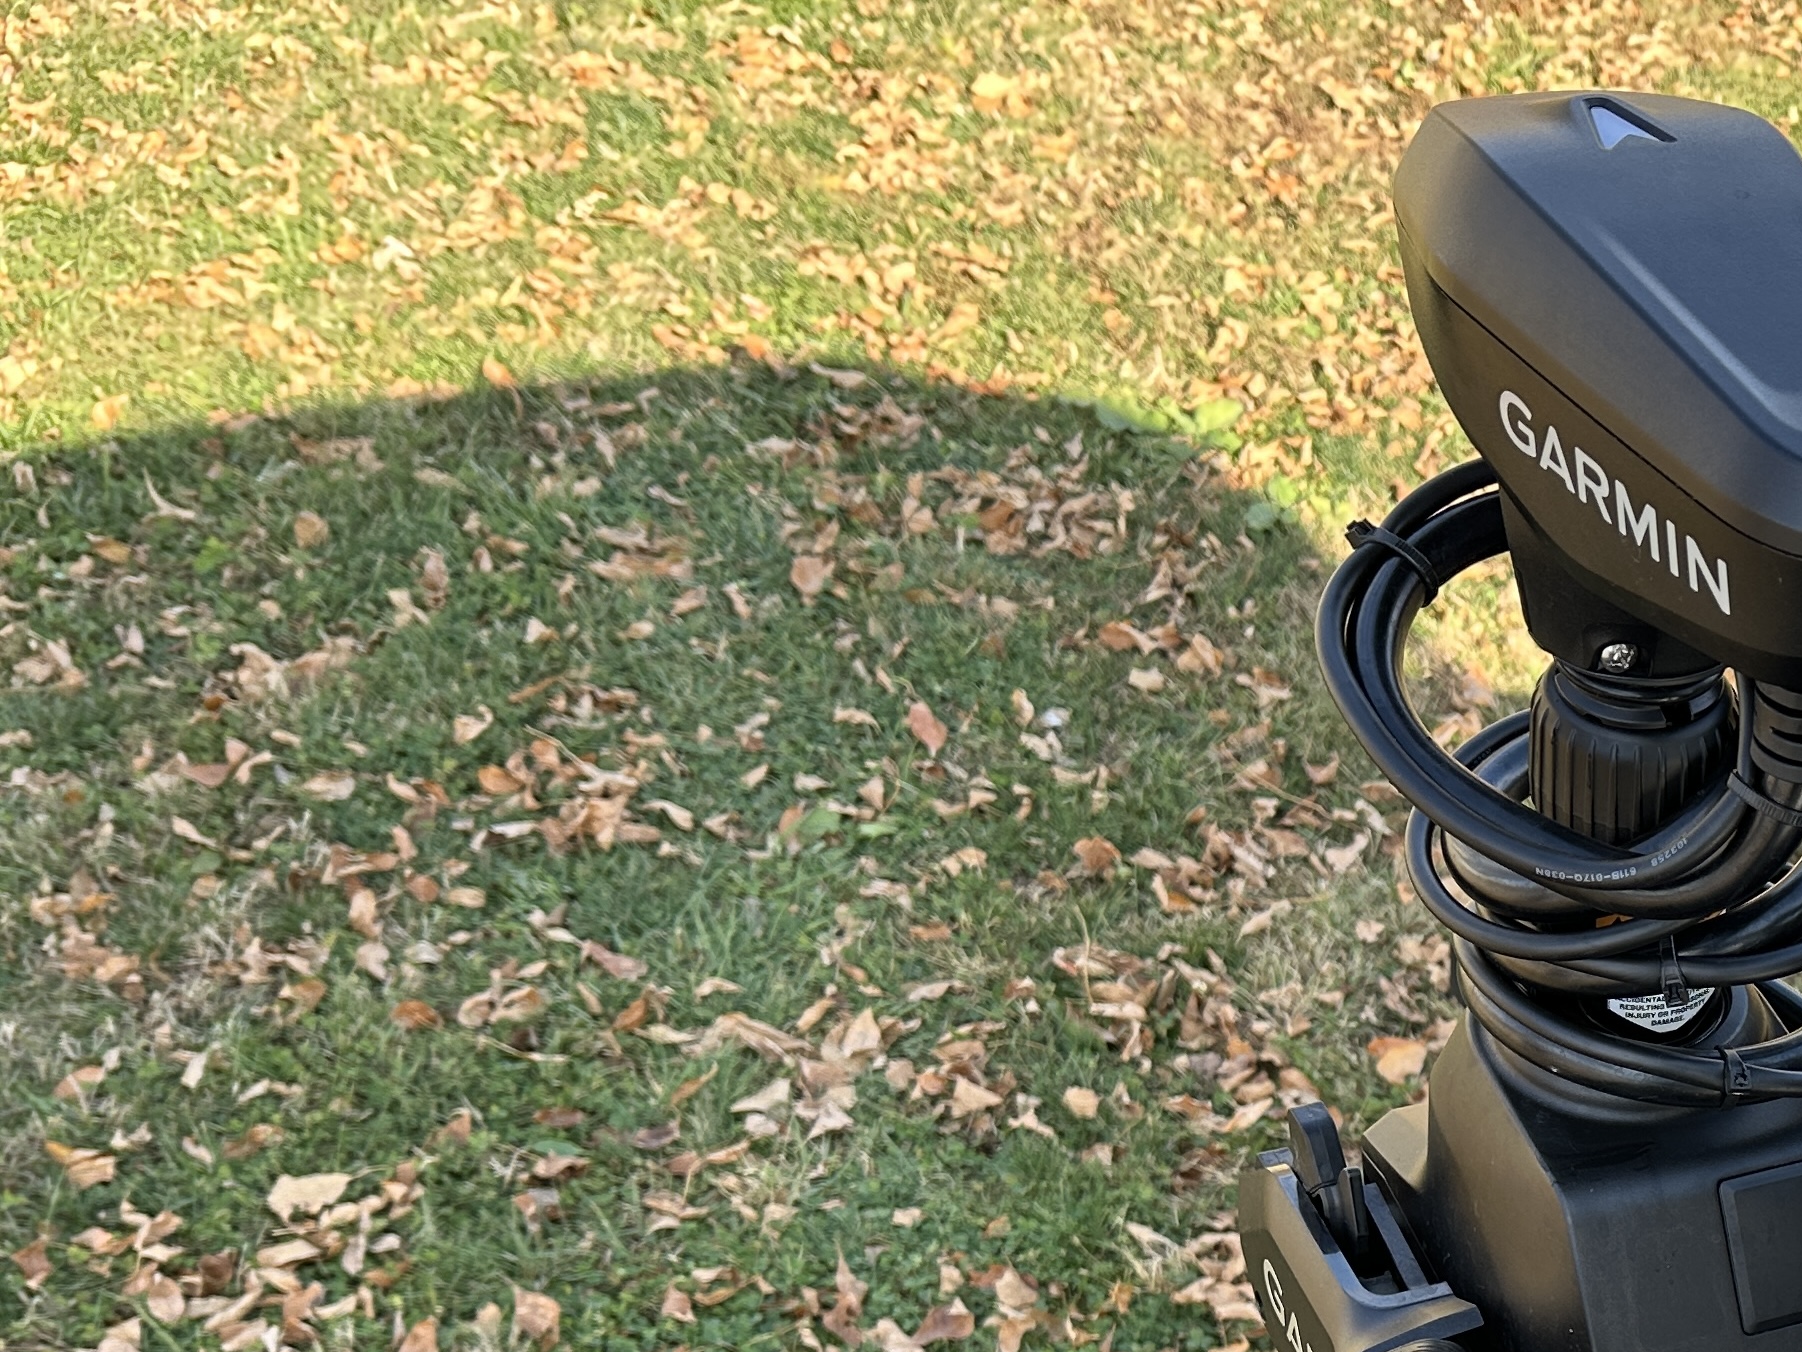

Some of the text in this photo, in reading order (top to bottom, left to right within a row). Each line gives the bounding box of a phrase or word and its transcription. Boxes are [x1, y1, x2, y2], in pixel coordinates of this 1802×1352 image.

[1499, 390, 1731, 616] GARMIN
[1625, 1011, 1656, 1019] INJURY
[1657, 1010, 1669, 1018] OR
